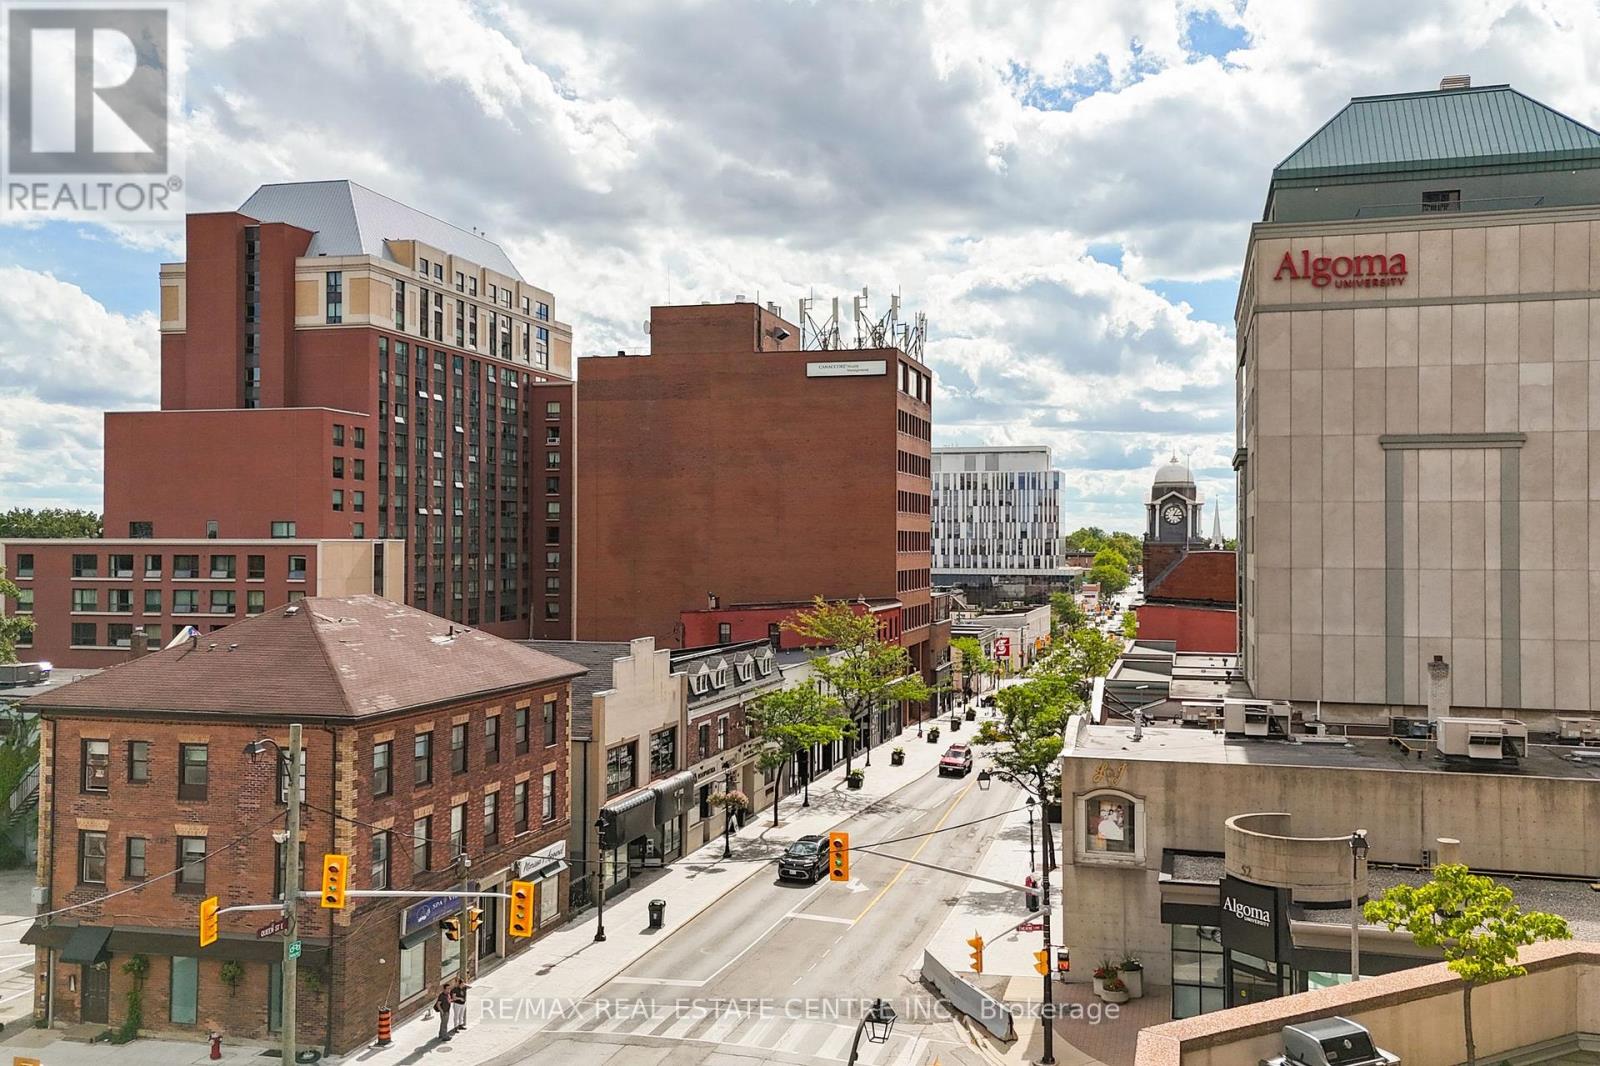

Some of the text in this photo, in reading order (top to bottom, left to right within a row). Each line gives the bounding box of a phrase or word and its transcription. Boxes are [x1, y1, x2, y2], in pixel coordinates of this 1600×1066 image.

[1273, 249, 1408, 288] Algoma
[1334, 278, 1406, 288] UNIVERSITY
[1223, 896, 1271, 922] Algoma
